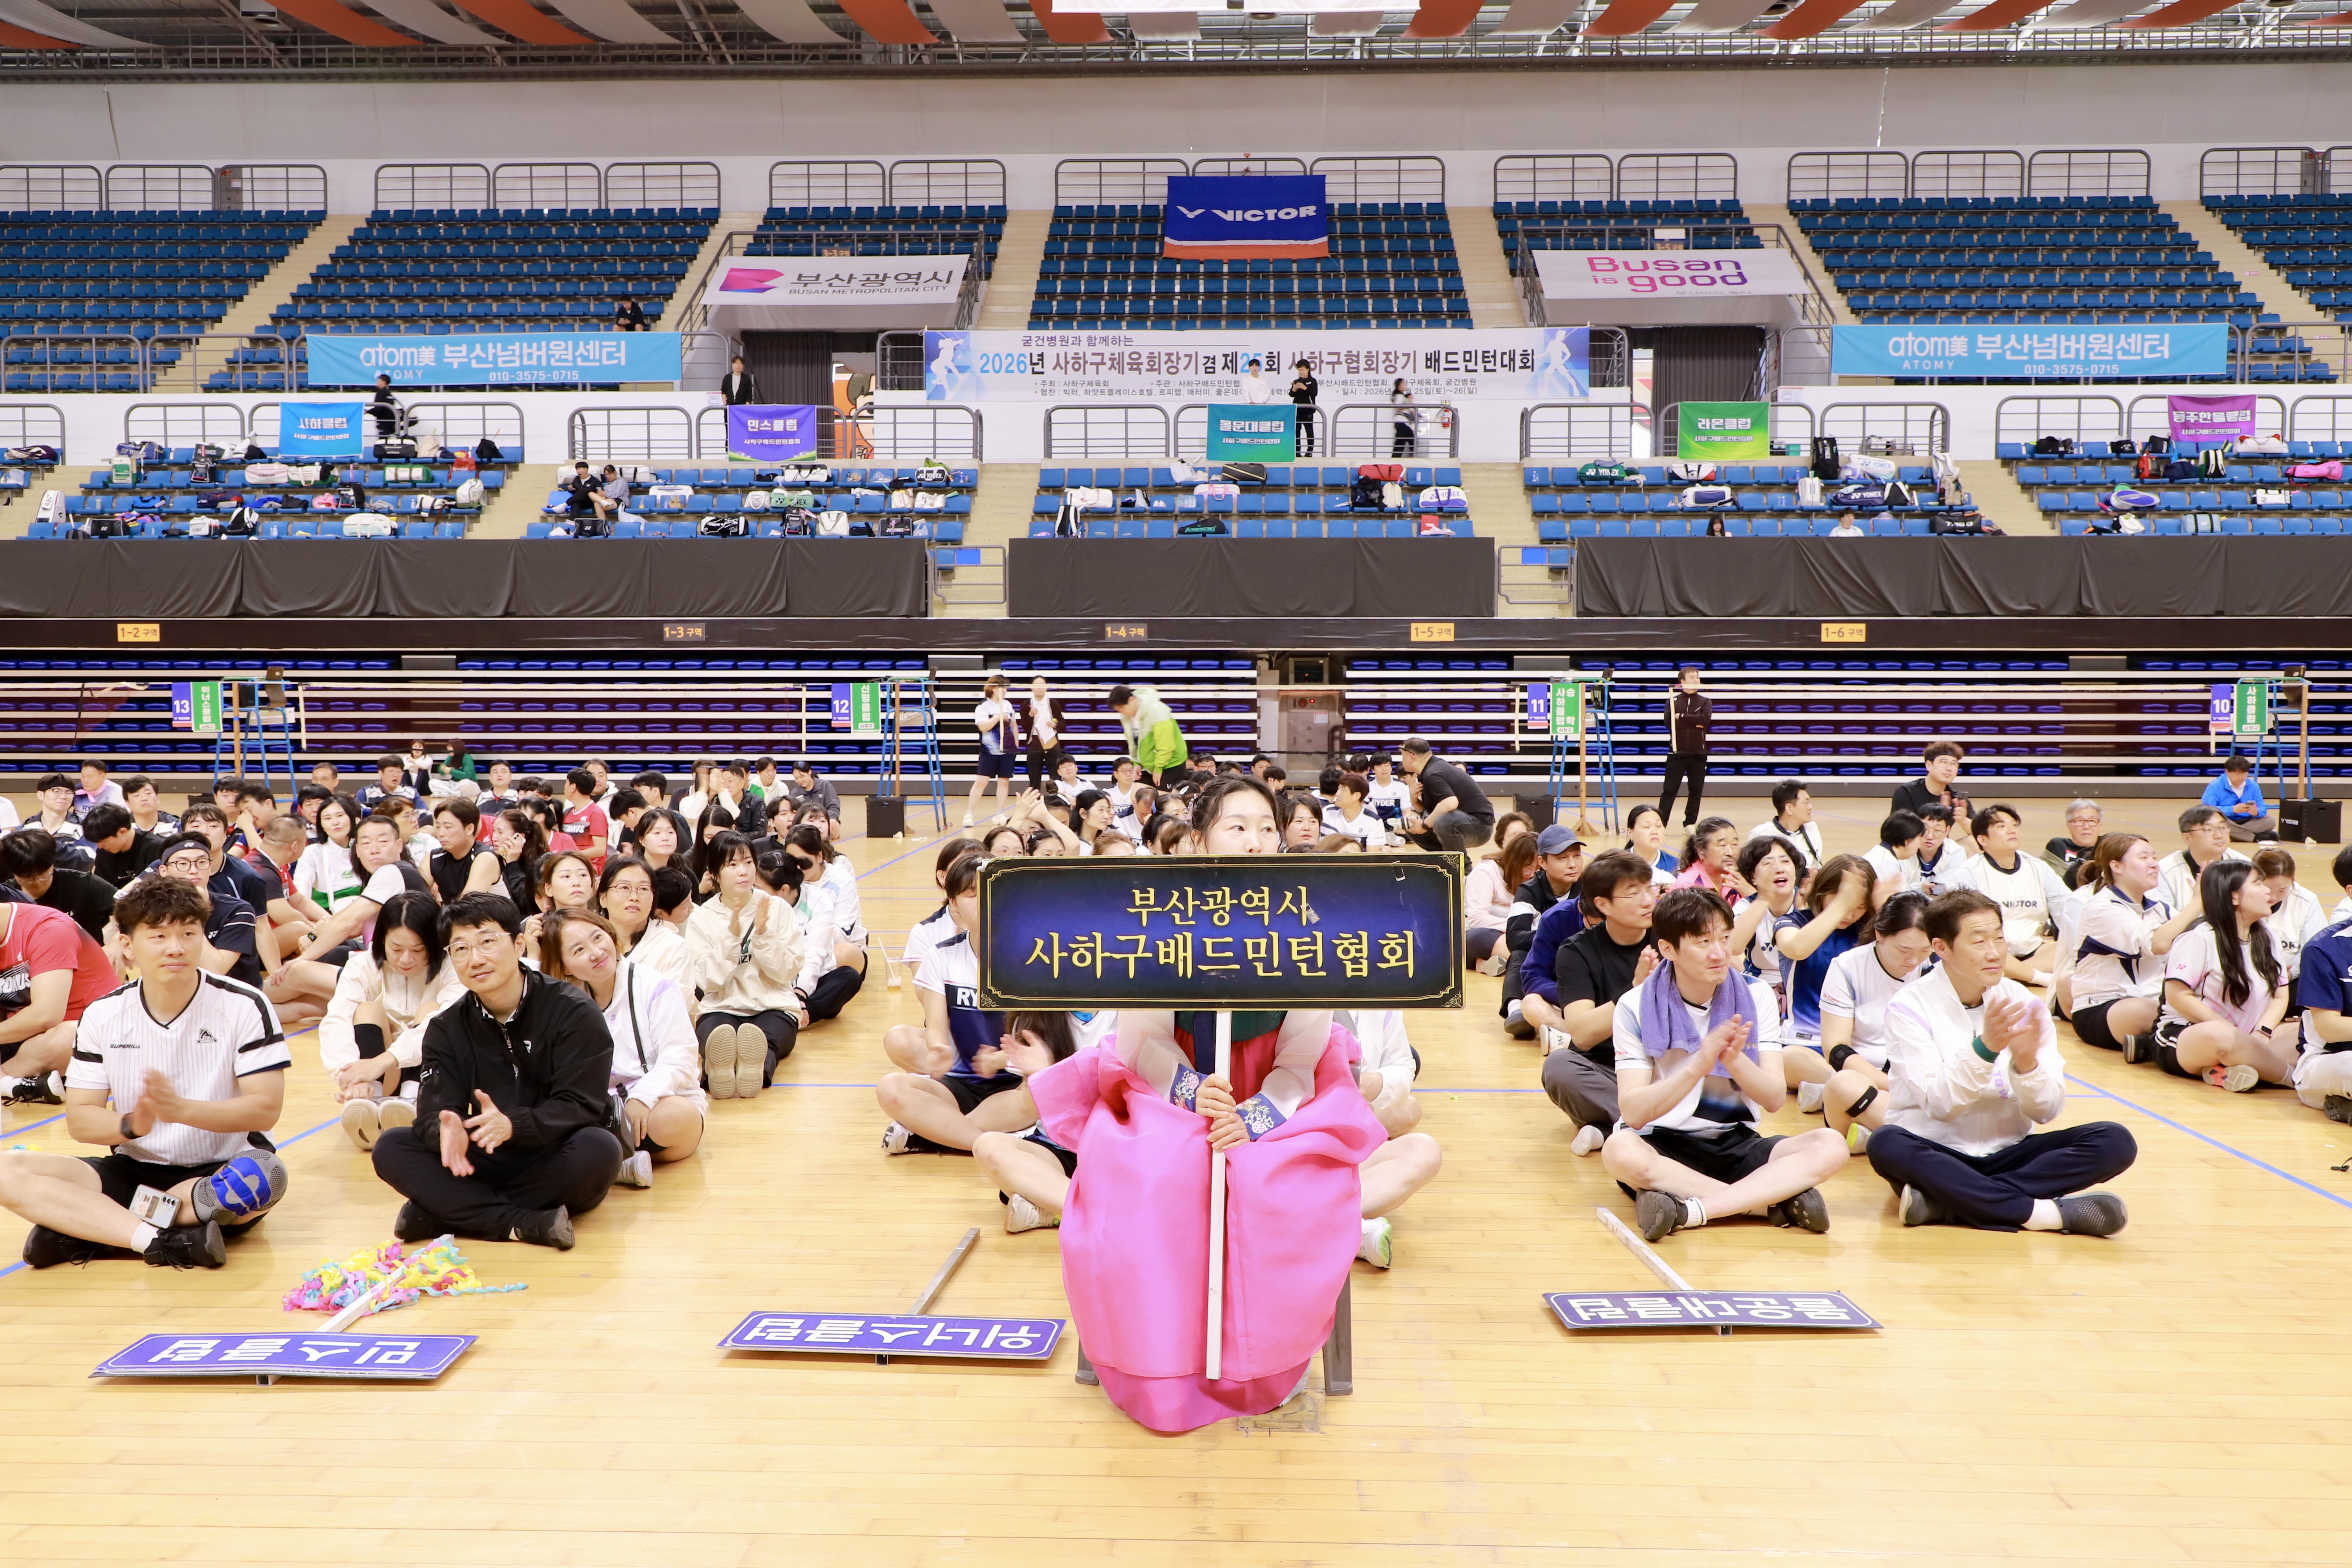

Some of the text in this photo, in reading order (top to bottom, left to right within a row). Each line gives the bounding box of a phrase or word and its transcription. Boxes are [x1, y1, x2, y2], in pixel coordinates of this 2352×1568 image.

[1211, 205, 1317, 222] VICTOR
[1587, 257, 1742, 272] Busan
[790, 270, 953, 288] 부산광역시
[1592, 272, 1748, 292] is good
[1022, 335, 1134, 347] 굳건병원과 함께하는
[1976, 332, 2169, 360] 부산넘버원센터
[443, 341, 626, 368] 부산넘버원센터
[980, 351, 1044, 375] 2026년
[1425, 349, 1534, 373] 배드민턴대회
[1903, 360, 1954, 370] ATOMY
[2024, 364, 2119, 374] 010-3575-0715
[374, 369, 424, 379] ATOMY
[489, 371, 579, 381] 010-3575-0715
[1445, 378, 1476, 386] 굳건병원
[298, 417, 348, 429] 사하클럽
[747, 419, 797, 431] 민스클럽
[1219, 419, 1284, 432] 몰운대클럽
[1697, 418, 1751, 430] 라온클럽
[121, 628, 139, 637] 1-2
[664, 626, 702, 638] 1-3 구역
[1106, 627, 1144, 638] 1-4 구역
[1414, 627, 1451, 637] 1-5 구역
[1825, 627, 1863, 637] 1-6 구역
[174, 700, 189, 714] 13
[201, 686, 211, 723] 위너스클럽
[833, 700, 849, 713] 12
[861, 684, 871, 721] 신평클럽
[1531, 699, 1545, 713] 11
[2213, 699, 2231, 713] 10
[2247, 686, 2257, 723] 사하클럽
[1127, 886, 1309, 927] 부산광역시
[1025, 930, 1415, 980] 사하구배드민턴협회
[1568, 1297, 1851, 1320] 몰운대클럽
[743, 1318, 1041, 1349] 위너스클럽
[147, 1338, 421, 1365] 민스클럽
